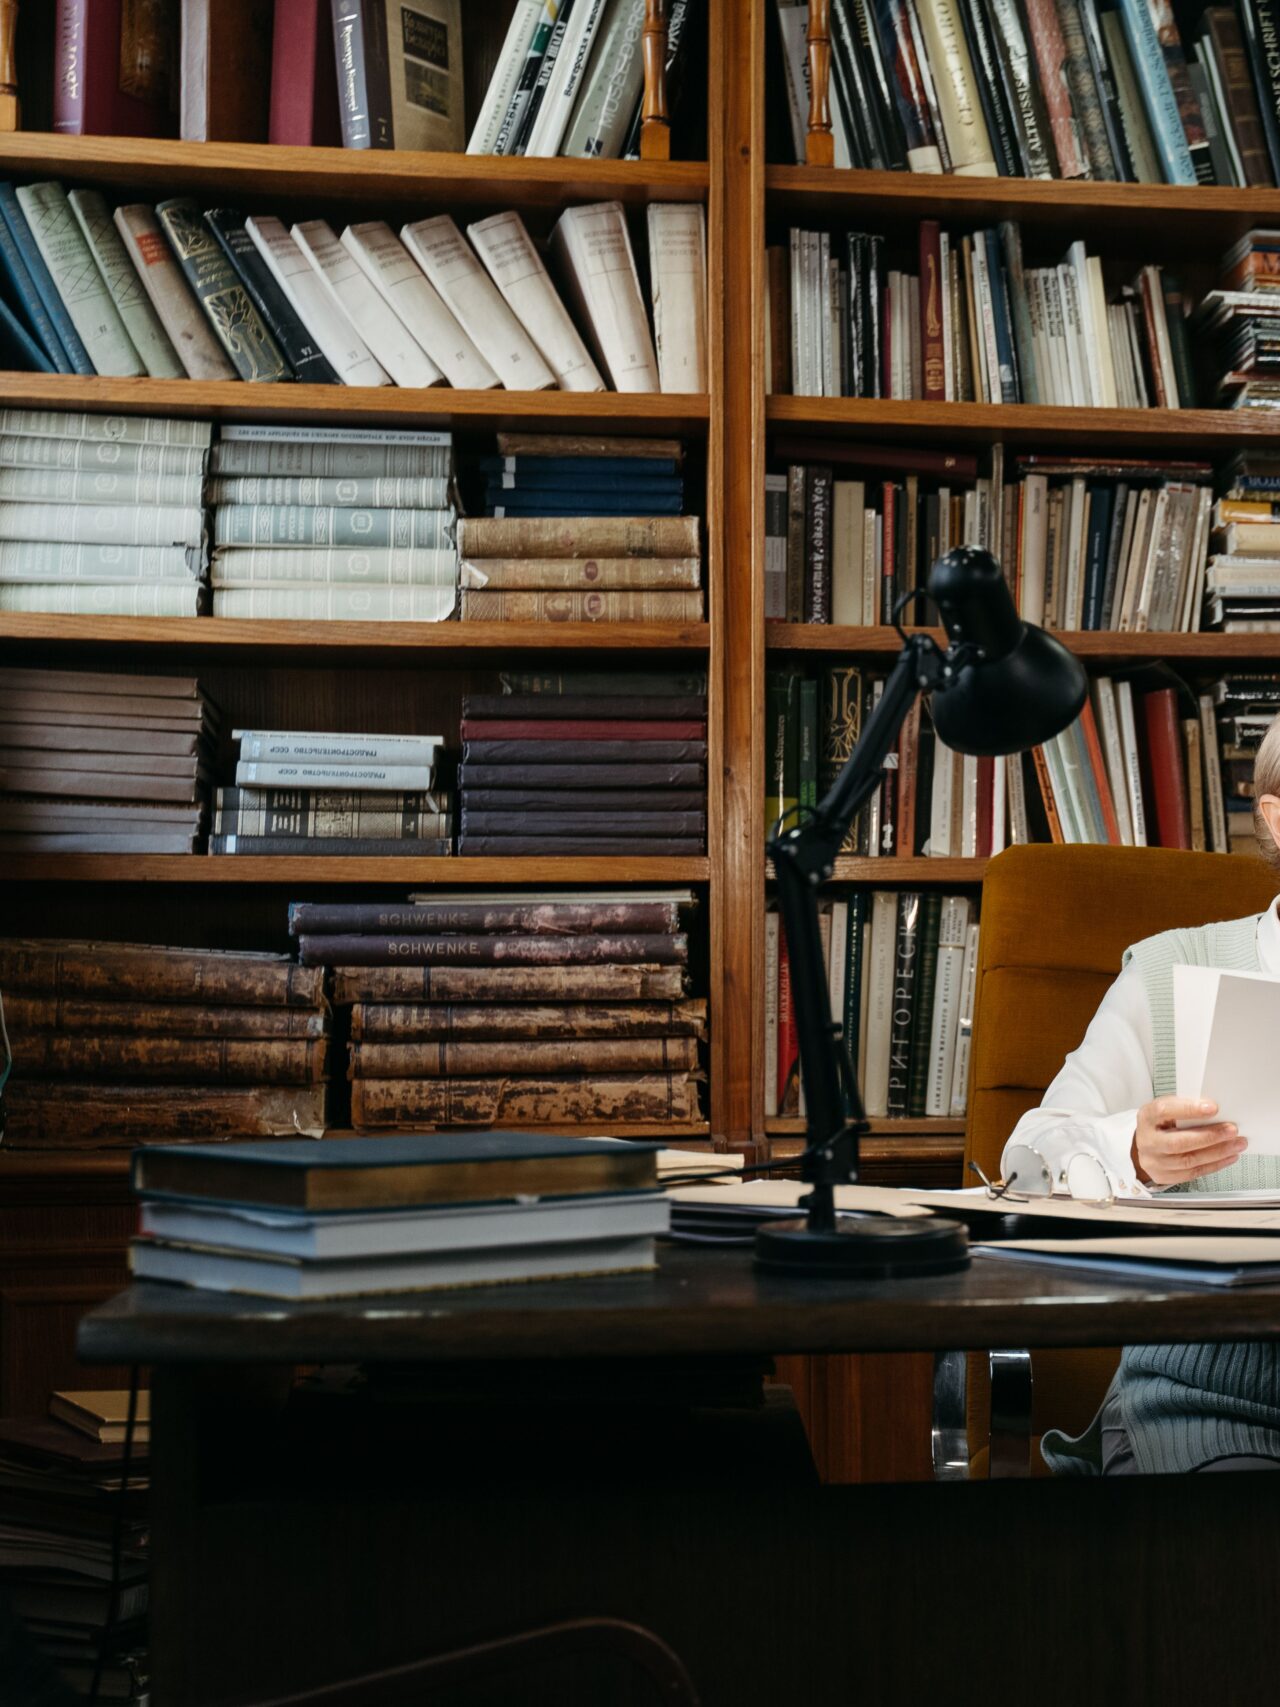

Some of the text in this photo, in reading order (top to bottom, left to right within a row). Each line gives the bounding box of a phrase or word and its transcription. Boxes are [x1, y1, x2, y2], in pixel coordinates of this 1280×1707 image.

[269, 745, 376, 757] ГРАДОСТРОИТЕЛЬСТВО СССР
[277, 767, 385, 779] ГРАДОСТРОИТЕЛЬСТВО СССР
